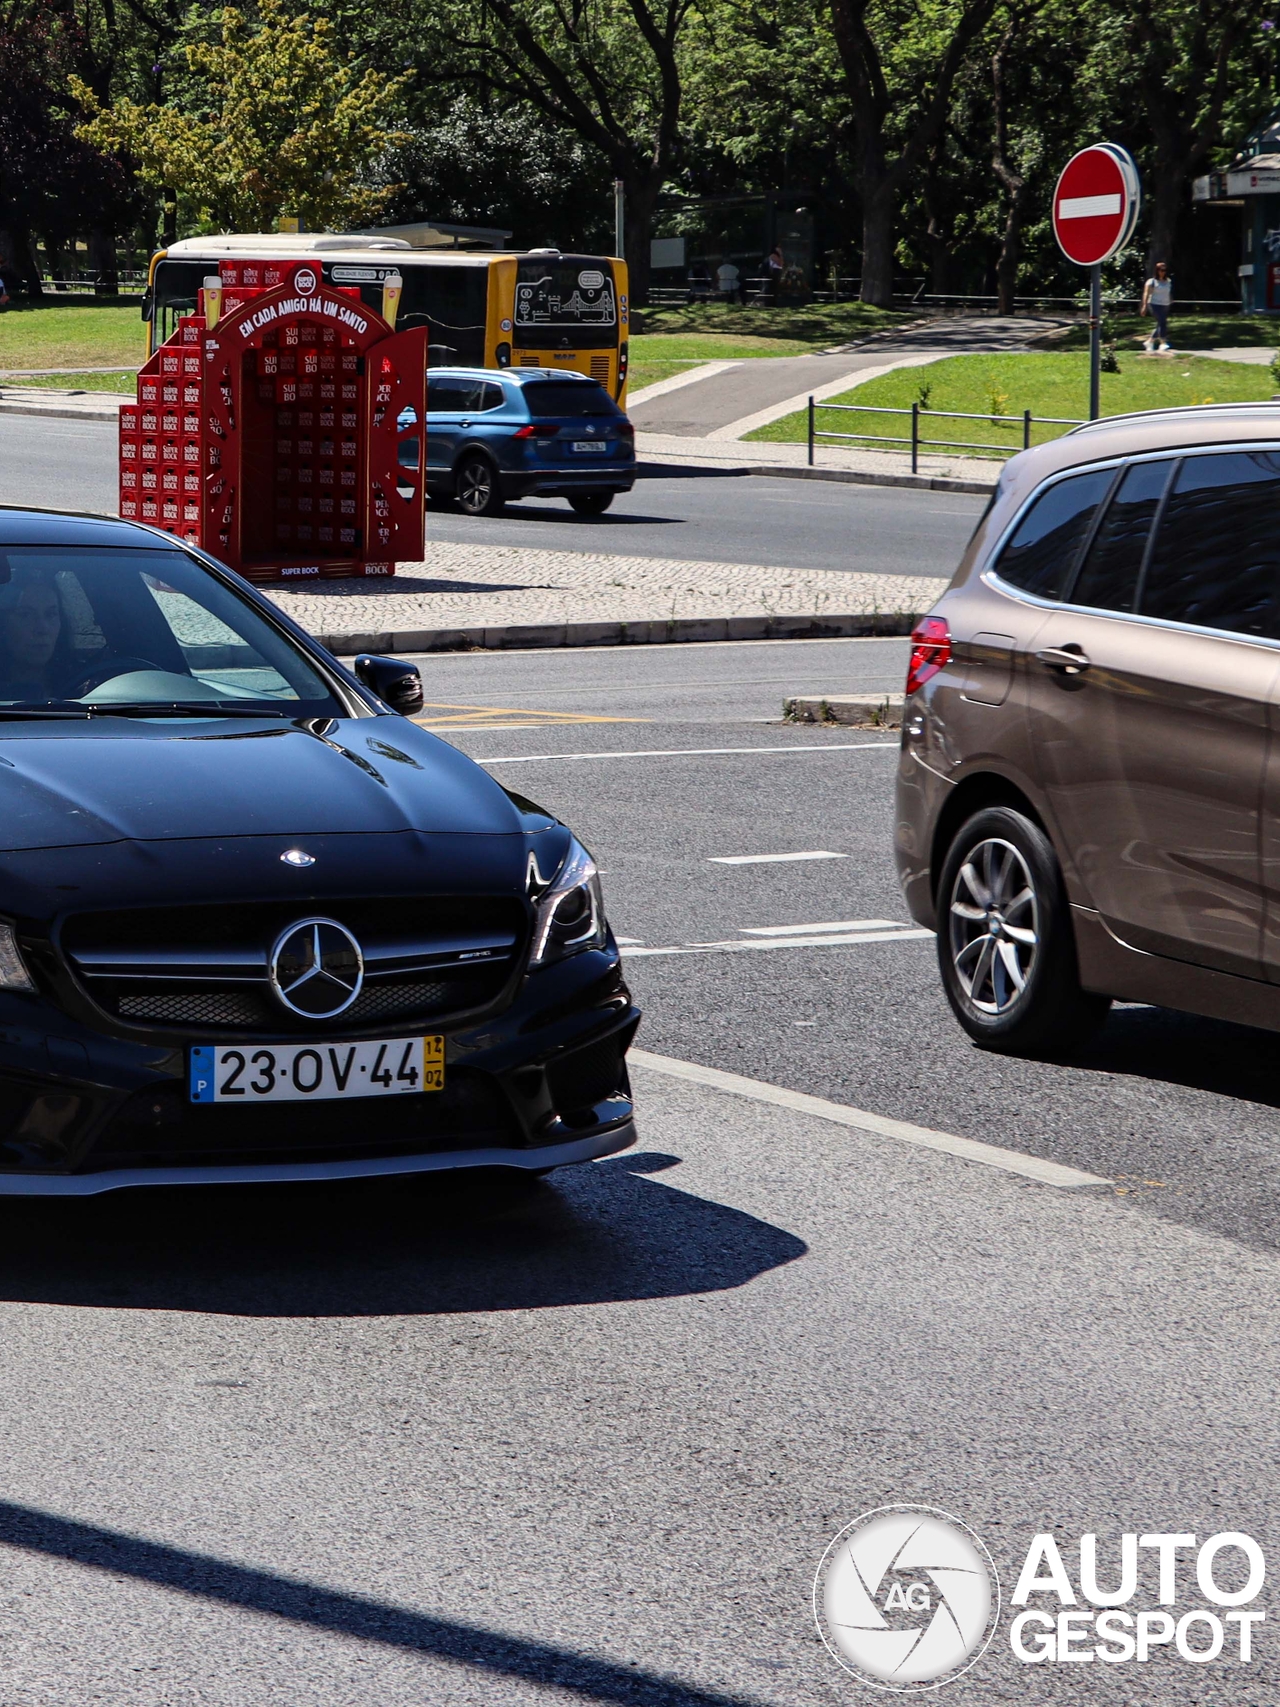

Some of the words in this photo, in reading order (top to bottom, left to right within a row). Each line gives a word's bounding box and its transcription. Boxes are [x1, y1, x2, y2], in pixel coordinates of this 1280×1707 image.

[238, 322, 253, 338] EM
[253, 308, 277, 330] CADA
[278, 298, 307, 315] AMIGO
[309, 296, 321, 312] HÁ
[323, 302, 337, 318] UM
[338, 308, 368, 334] SANTO
[184, 358, 199, 366] SUPER
[164, 364, 177, 372] BOCK
[142, 386, 156, 394] SUPER
[184, 388, 199, 396] SUPER
[142, 415, 156, 423] SUPER
[143, 422, 156, 430] BOCK
[142, 444, 156, 452] SUPER
[163, 445, 178, 453] SUPER
[184, 446, 199, 454] SUPER
[163, 452, 177, 460] BOCK
[184, 453, 198, 461] BOCK
[122, 472, 136, 480] SUPER
[142, 473, 156, 481] SUPER
[122, 479, 136, 487] BOCK
[143, 480, 156, 488] BOCK
[142, 502, 156, 510] SUPER
[184, 505, 199, 513] SUPER
[122, 508, 136, 516] BOCK
[143, 509, 156, 517] BOCK
[163, 510, 177, 518] BOCK
[184, 512, 198, 520] BOCK
[365, 566, 388, 574] BOCK
[426, 1040, 442, 1054] 14
[198, 1080, 207, 1092] P
